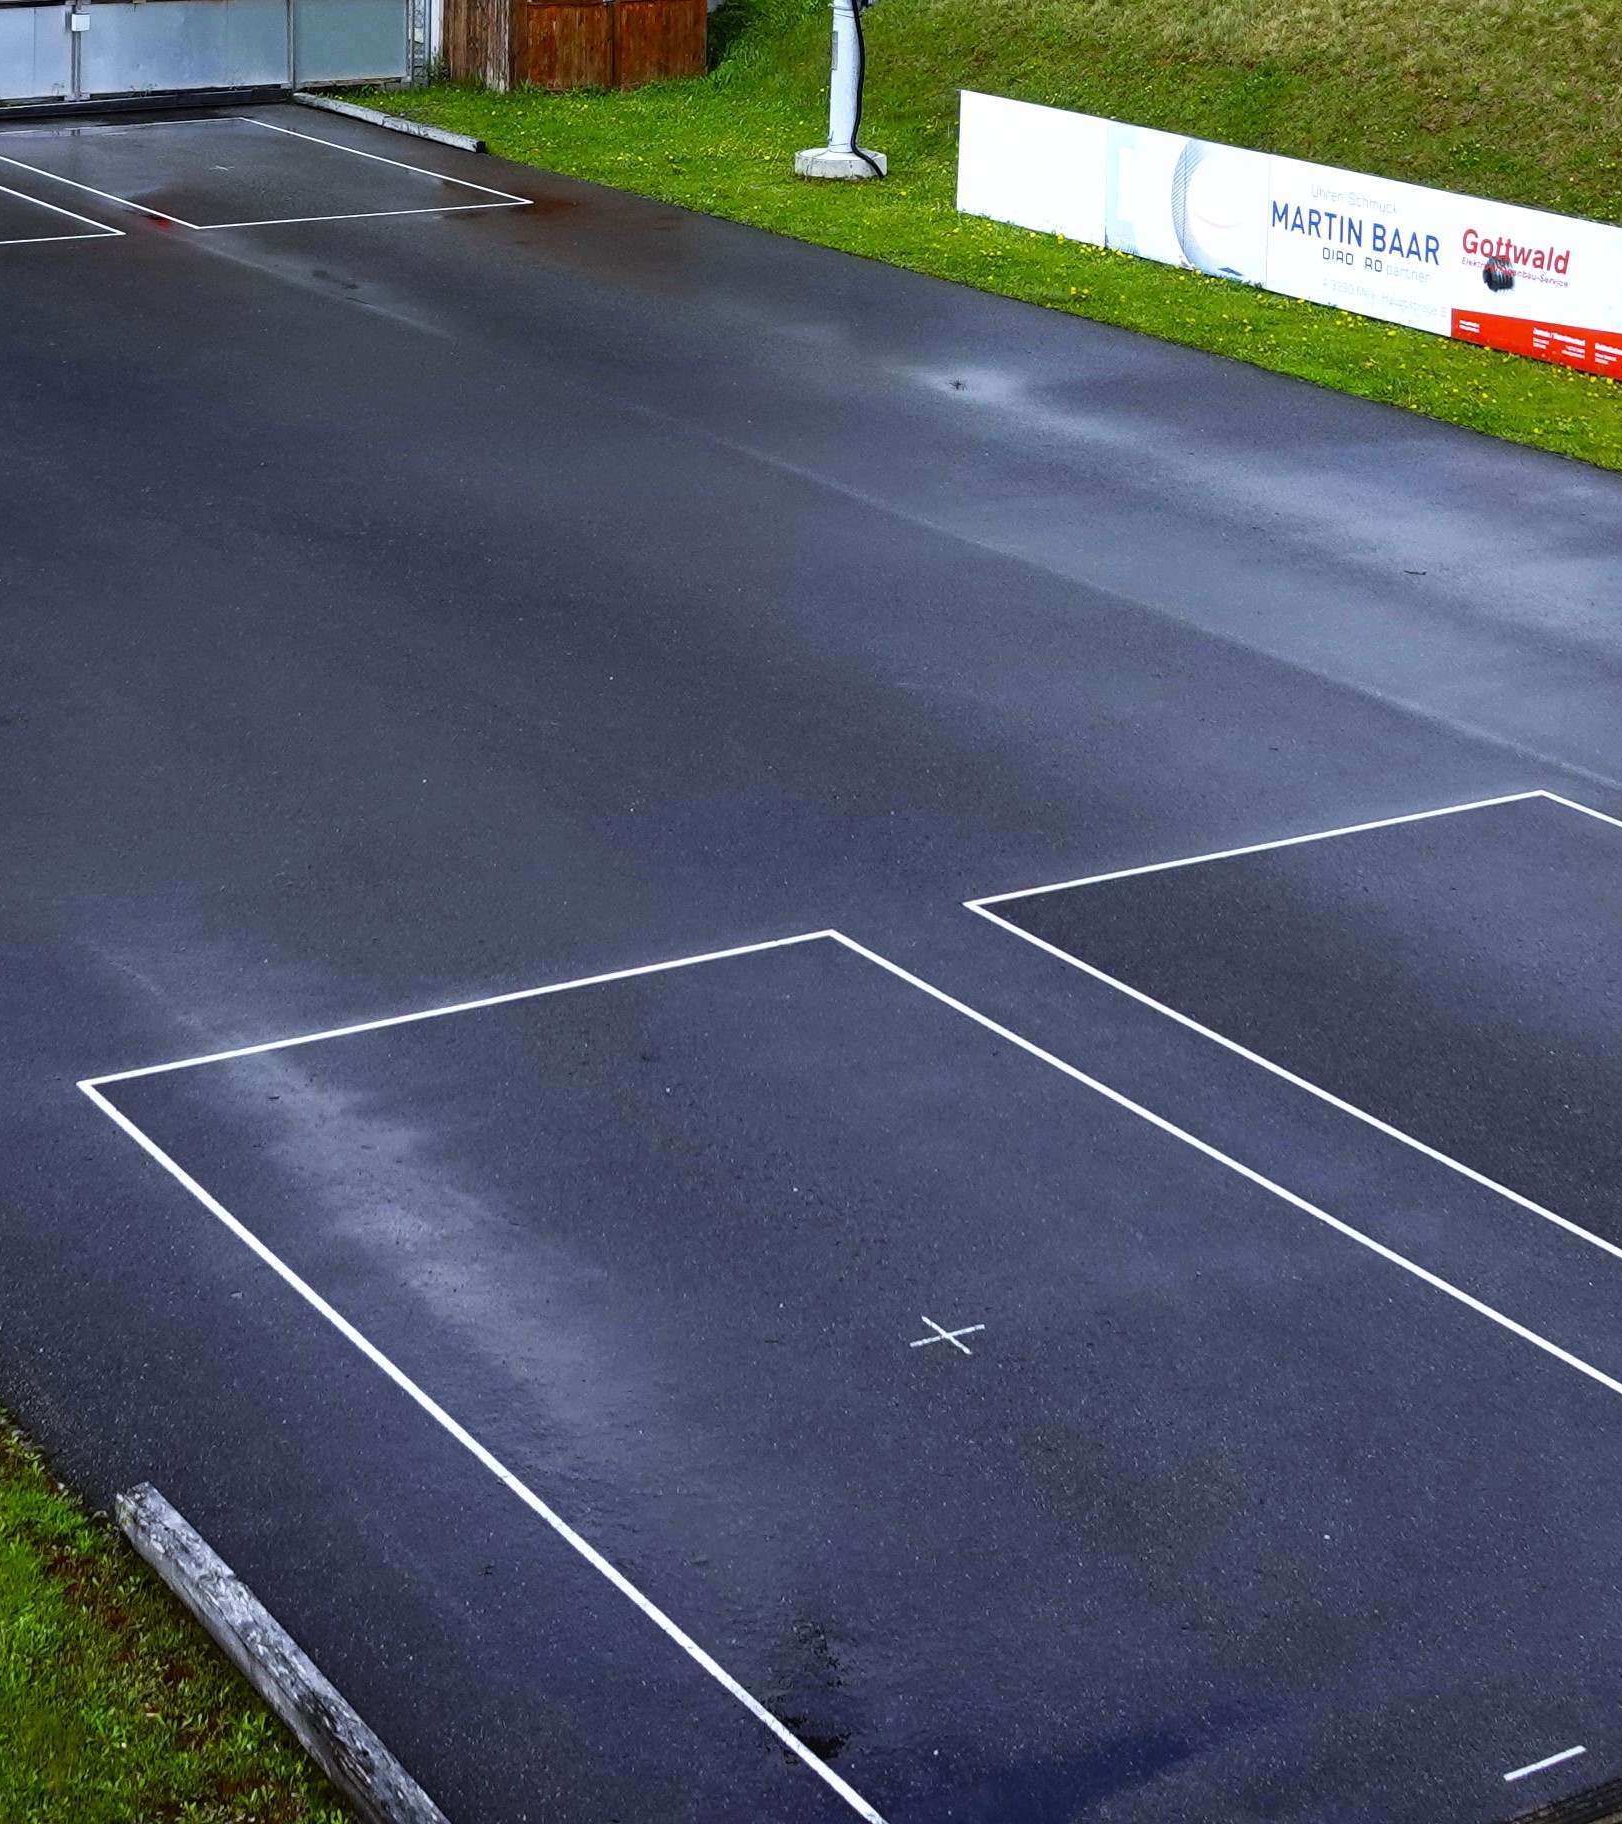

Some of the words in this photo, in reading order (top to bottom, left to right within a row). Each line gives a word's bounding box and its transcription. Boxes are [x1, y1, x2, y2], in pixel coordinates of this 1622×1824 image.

[1271, 199, 1364, 248] MARTIN
[1371, 223, 1441, 267] BAAR
[1462, 228, 1571, 276] Gottwald
